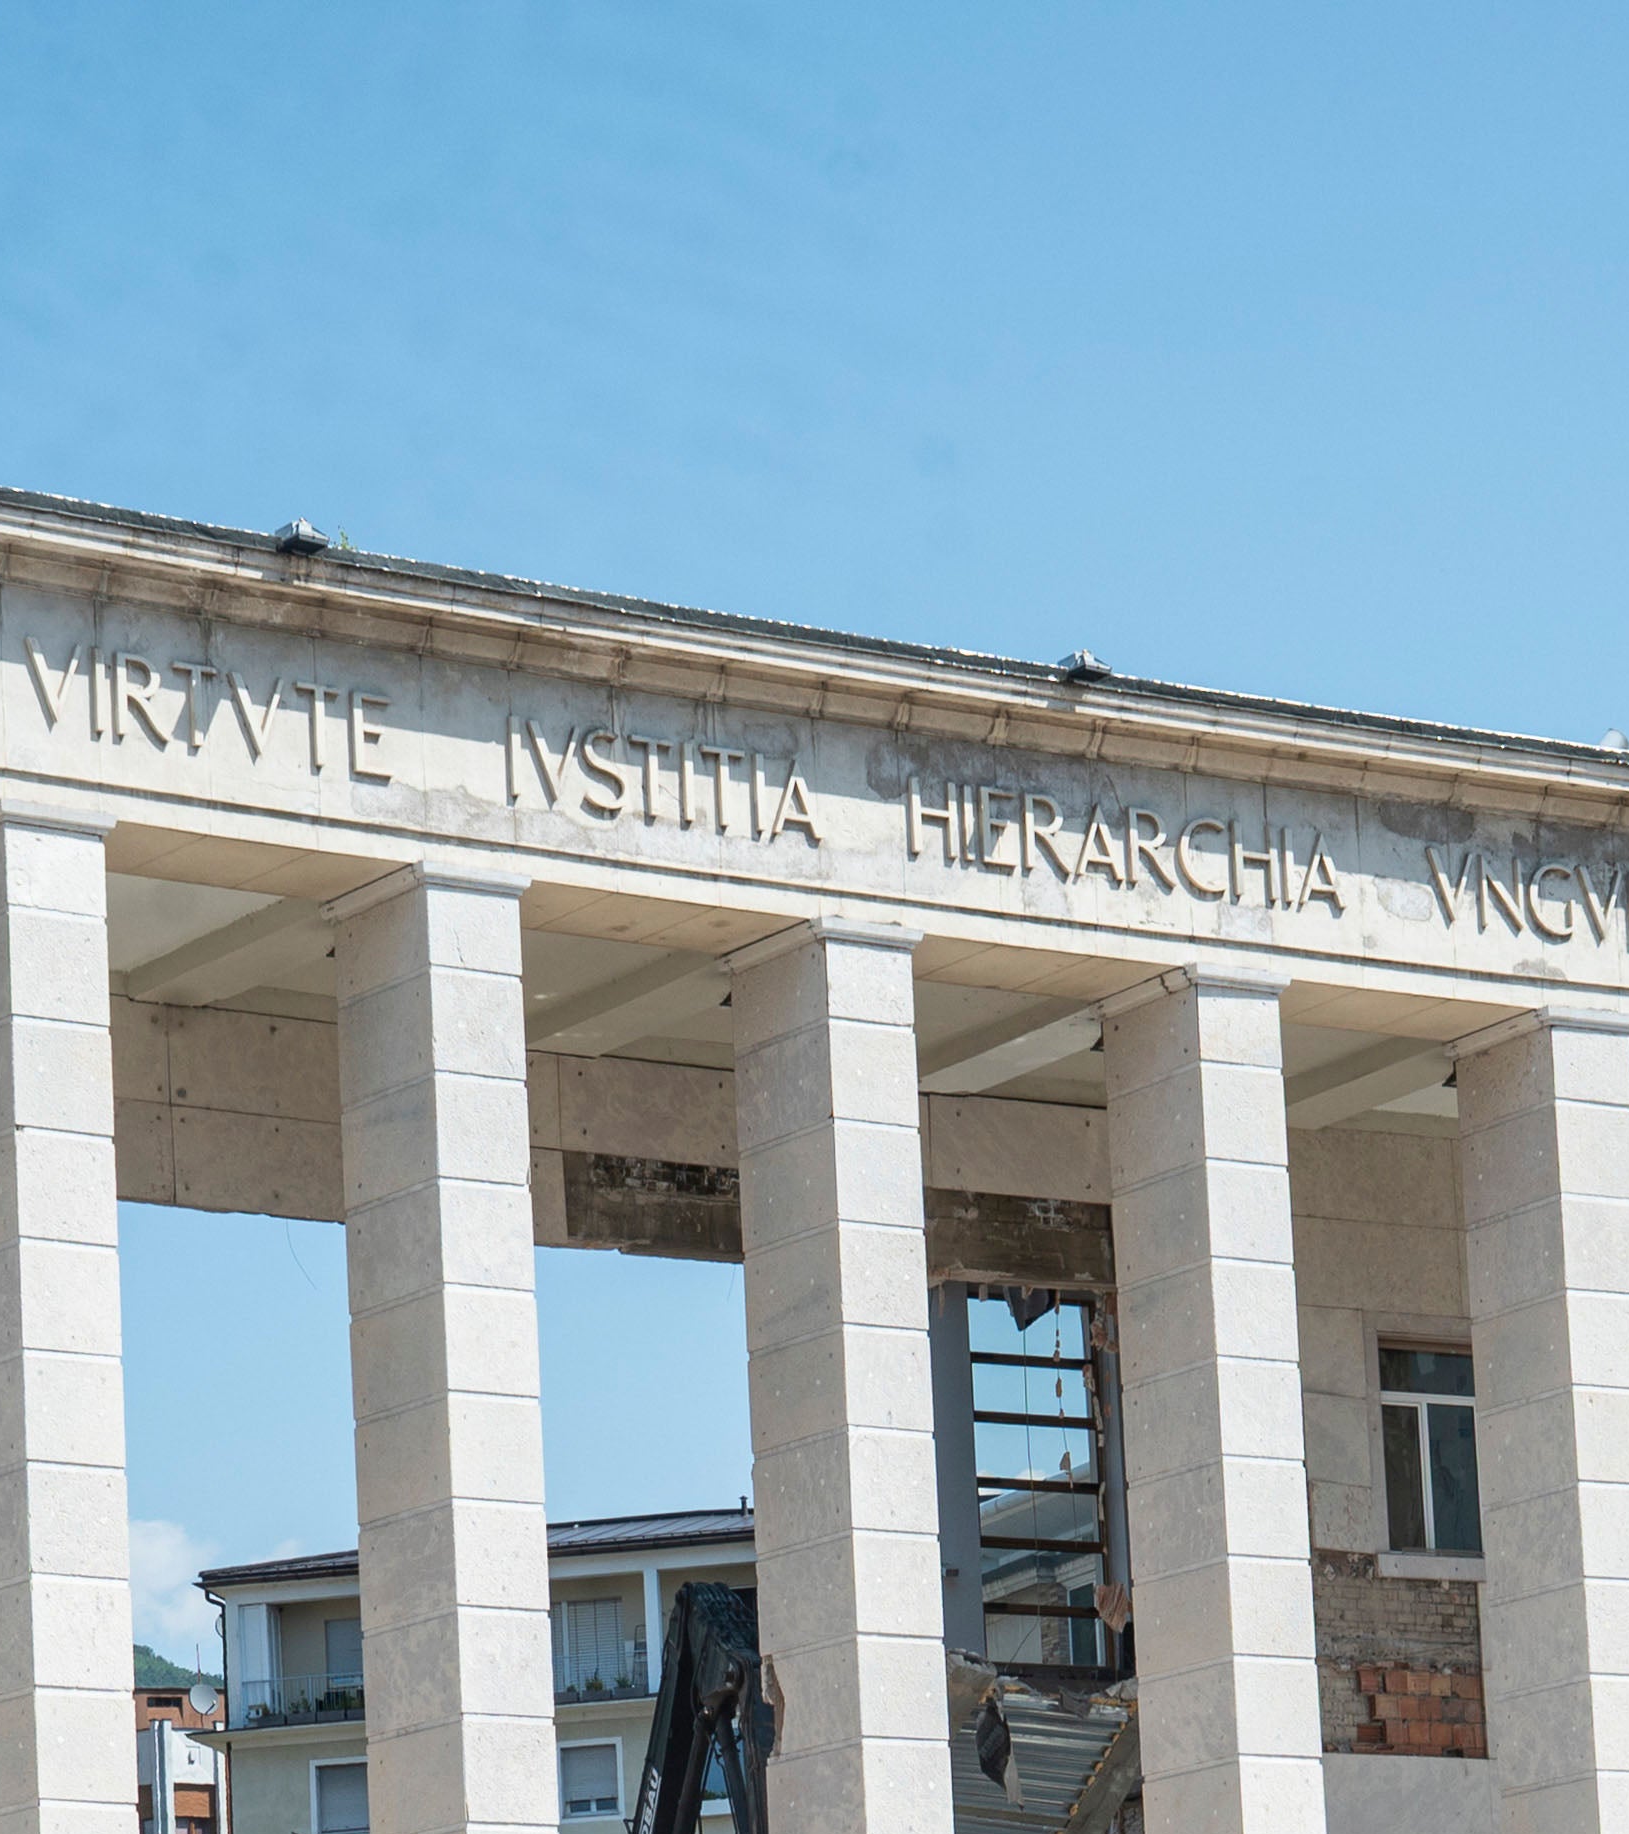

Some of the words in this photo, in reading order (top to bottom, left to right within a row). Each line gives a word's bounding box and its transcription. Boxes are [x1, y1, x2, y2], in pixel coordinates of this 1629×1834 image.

[25, 636, 394, 783] VIRTVTE
[506, 714, 823, 844] IVSTITIA
[907, 775, 1348, 912] HIERARCHIA
